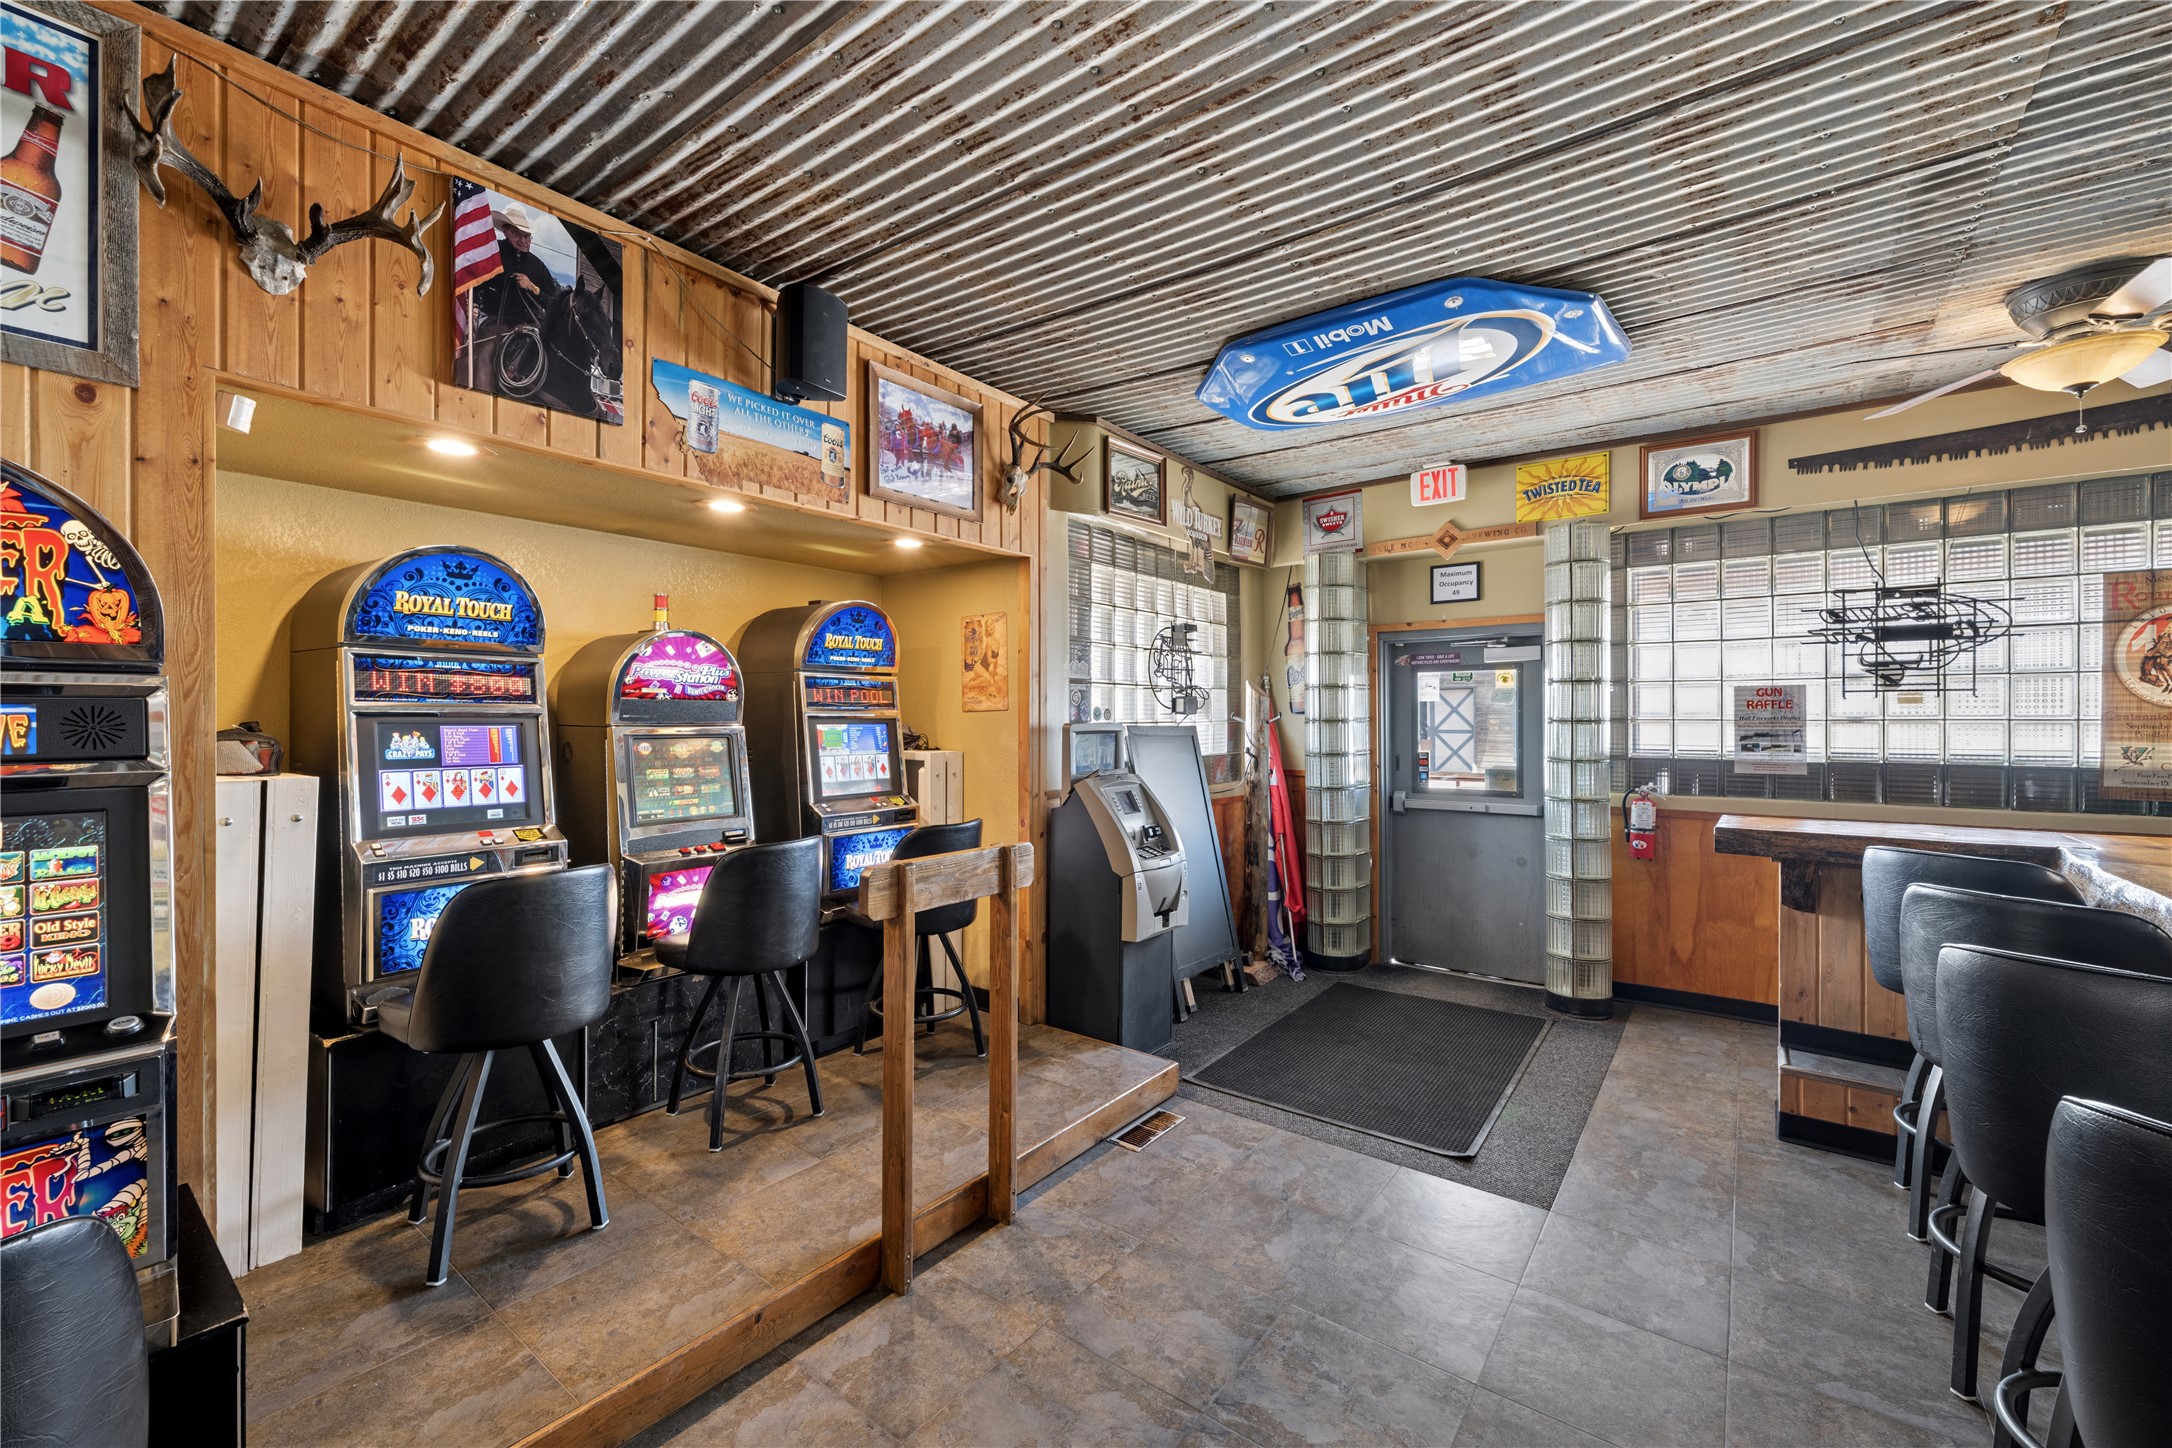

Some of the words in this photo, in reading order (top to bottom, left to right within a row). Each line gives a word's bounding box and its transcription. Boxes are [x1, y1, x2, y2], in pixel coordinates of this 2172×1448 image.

[1314, 316, 1394, 350] Mobil
[1285, 322, 1473, 419] Lite
[691, 390, 718, 409] Coors
[1335, 382, 1471, 419] Miller
[727, 393, 743, 405] WE
[745, 399, 779, 417] PICKED
[781, 411, 790, 420] IT
[792, 415, 816, 429] OVER
[734, 406, 752, 420] ALL
[753, 412, 772, 426] THE
[774, 418, 809, 437] OTHERS
[823, 434, 844, 448] Coors
[1419, 467, 1459, 502] EXIT
[1522, 479, 1577, 502] TWISTED
[1578, 478, 1601, 494] TEA
[1658, 473, 1739, 498] OLYMPIA
[1171, 498, 1193, 528] WILD
[1193, 506, 1223, 538] TURKEY
[1319, 514, 1345, 524] SWISHER
[1253, 528, 1265, 554] R
[1440, 570, 1473, 578] Maximum
[1439, 579, 1474, 588] Occupancy
[393, 590, 455, 616] ROYAL
[456, 596, 514, 622] TOUCH
[407, 624, 439, 634] POKER
[442, 627, 469, 635] KENO
[471, 629, 499, 638] REELS
[824, 632, 854, 650] ROYAL
[855, 635, 884, 652] TOUCH
[631, 663, 679, 680] Power
[699, 665, 732, 677] Plus
[673, 671, 720, 685] Station
[371, 670, 435, 692] WIN
[812, 688, 844, 703] WIN
[850, 690, 889, 704] POOL
[1756, 687, 1783, 697] GUN
[1746, 699, 1794, 709] RAFFLE
[387, 750, 411, 759] CRAZY
[415, 749, 433, 758] PAYS
[2121, 779, 2160, 787] September
[845, 853, 875, 870] ROYAL
[378, 872, 385, 881] $1
[387, 871, 395, 881] $5
[397, 869, 407, 880] $10
[409, 868, 421, 878] $20
[422, 866, 433, 876] $50
[434, 865, 449, 875] $100
[450, 862, 468, 872] BILLS
[34, 921, 61, 934] Old
[63, 917, 96, 932] Style
[41, 929, 91, 942] KENO
[33, 954, 63, 981] Lucky
[65, 953, 93, 971] Devil
[19, 1011, 50, 1021] CASHES
